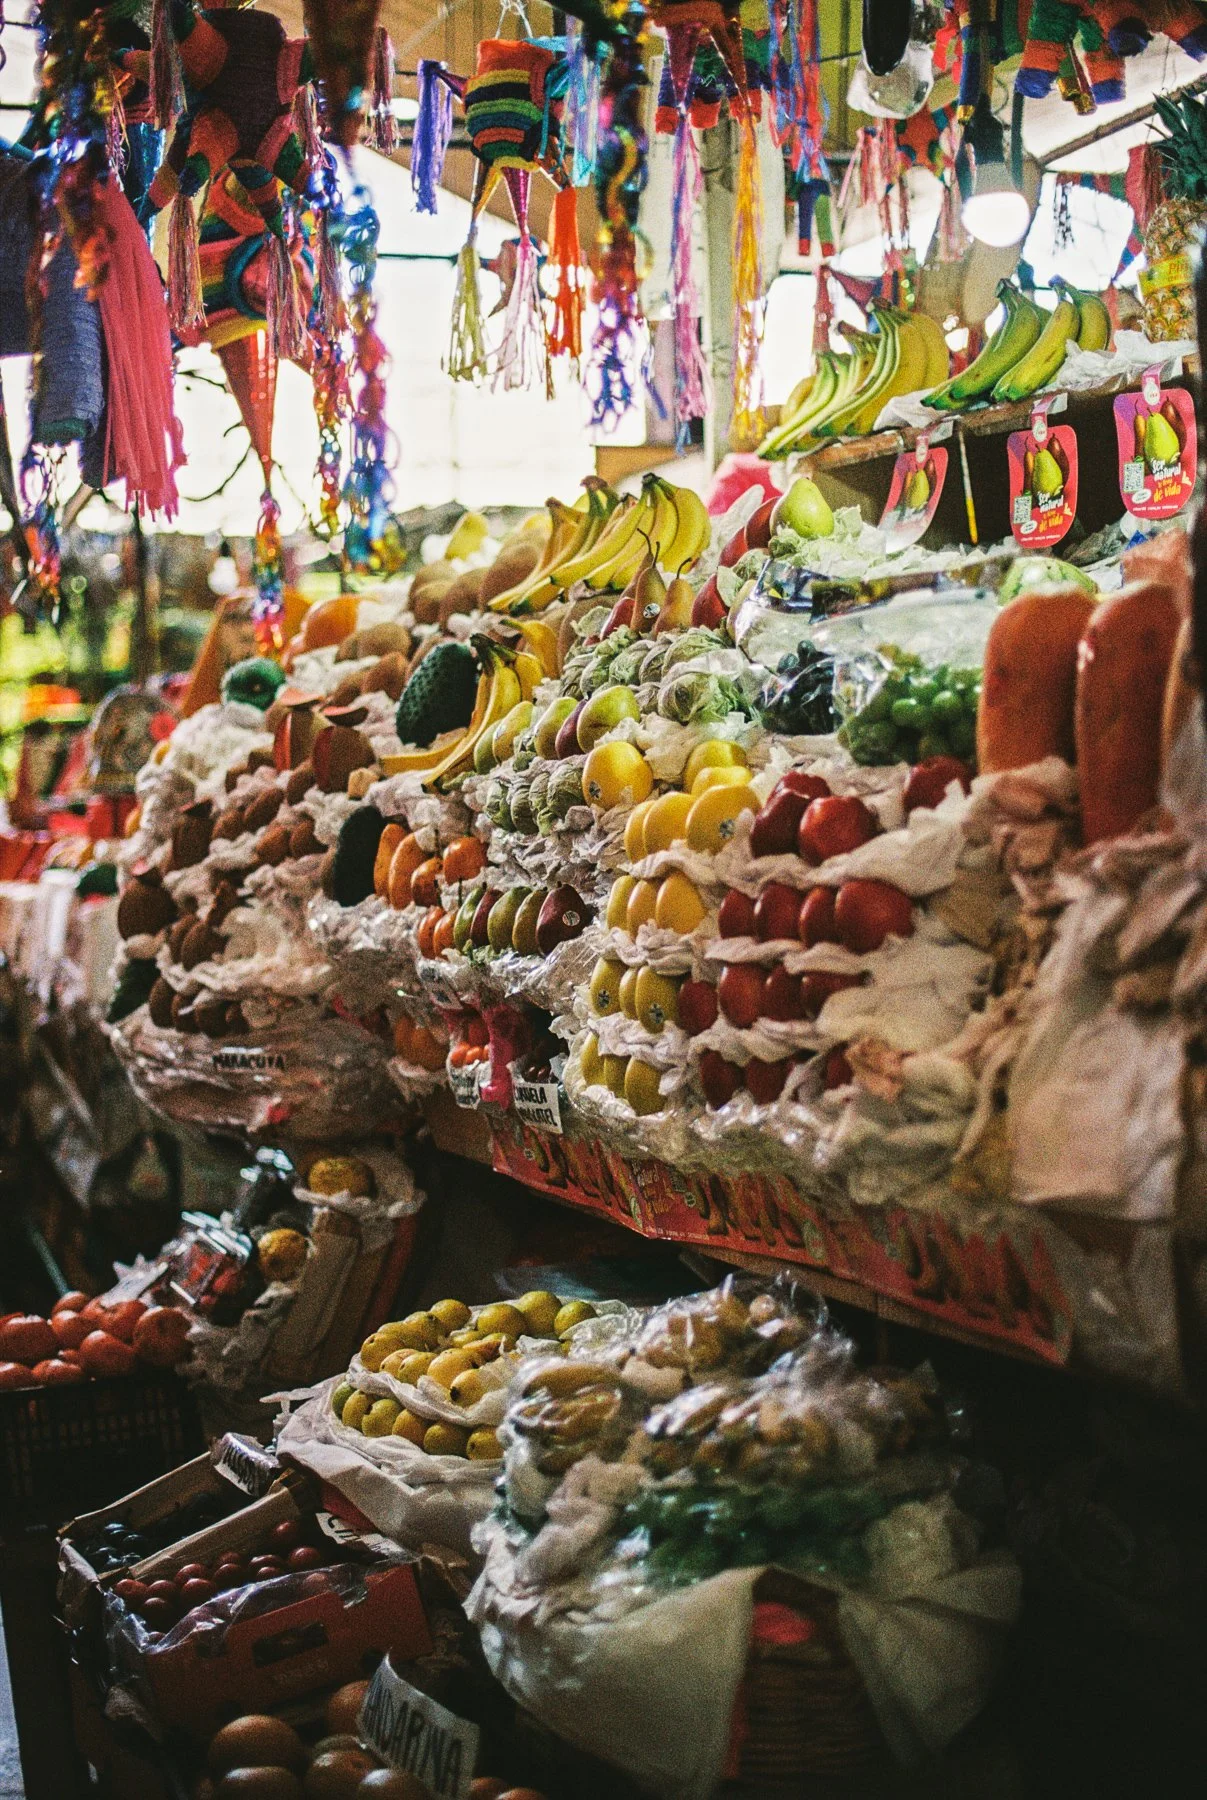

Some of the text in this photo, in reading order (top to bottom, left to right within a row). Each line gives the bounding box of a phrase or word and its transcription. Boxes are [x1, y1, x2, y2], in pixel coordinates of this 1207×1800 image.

[1154, 462, 1181, 481] natural
[1153, 488, 1163, 503] de
[1164, 482, 1181, 498] vida
[1040, 495, 1064, 513] natural
[1048, 513, 1064, 528] vida
